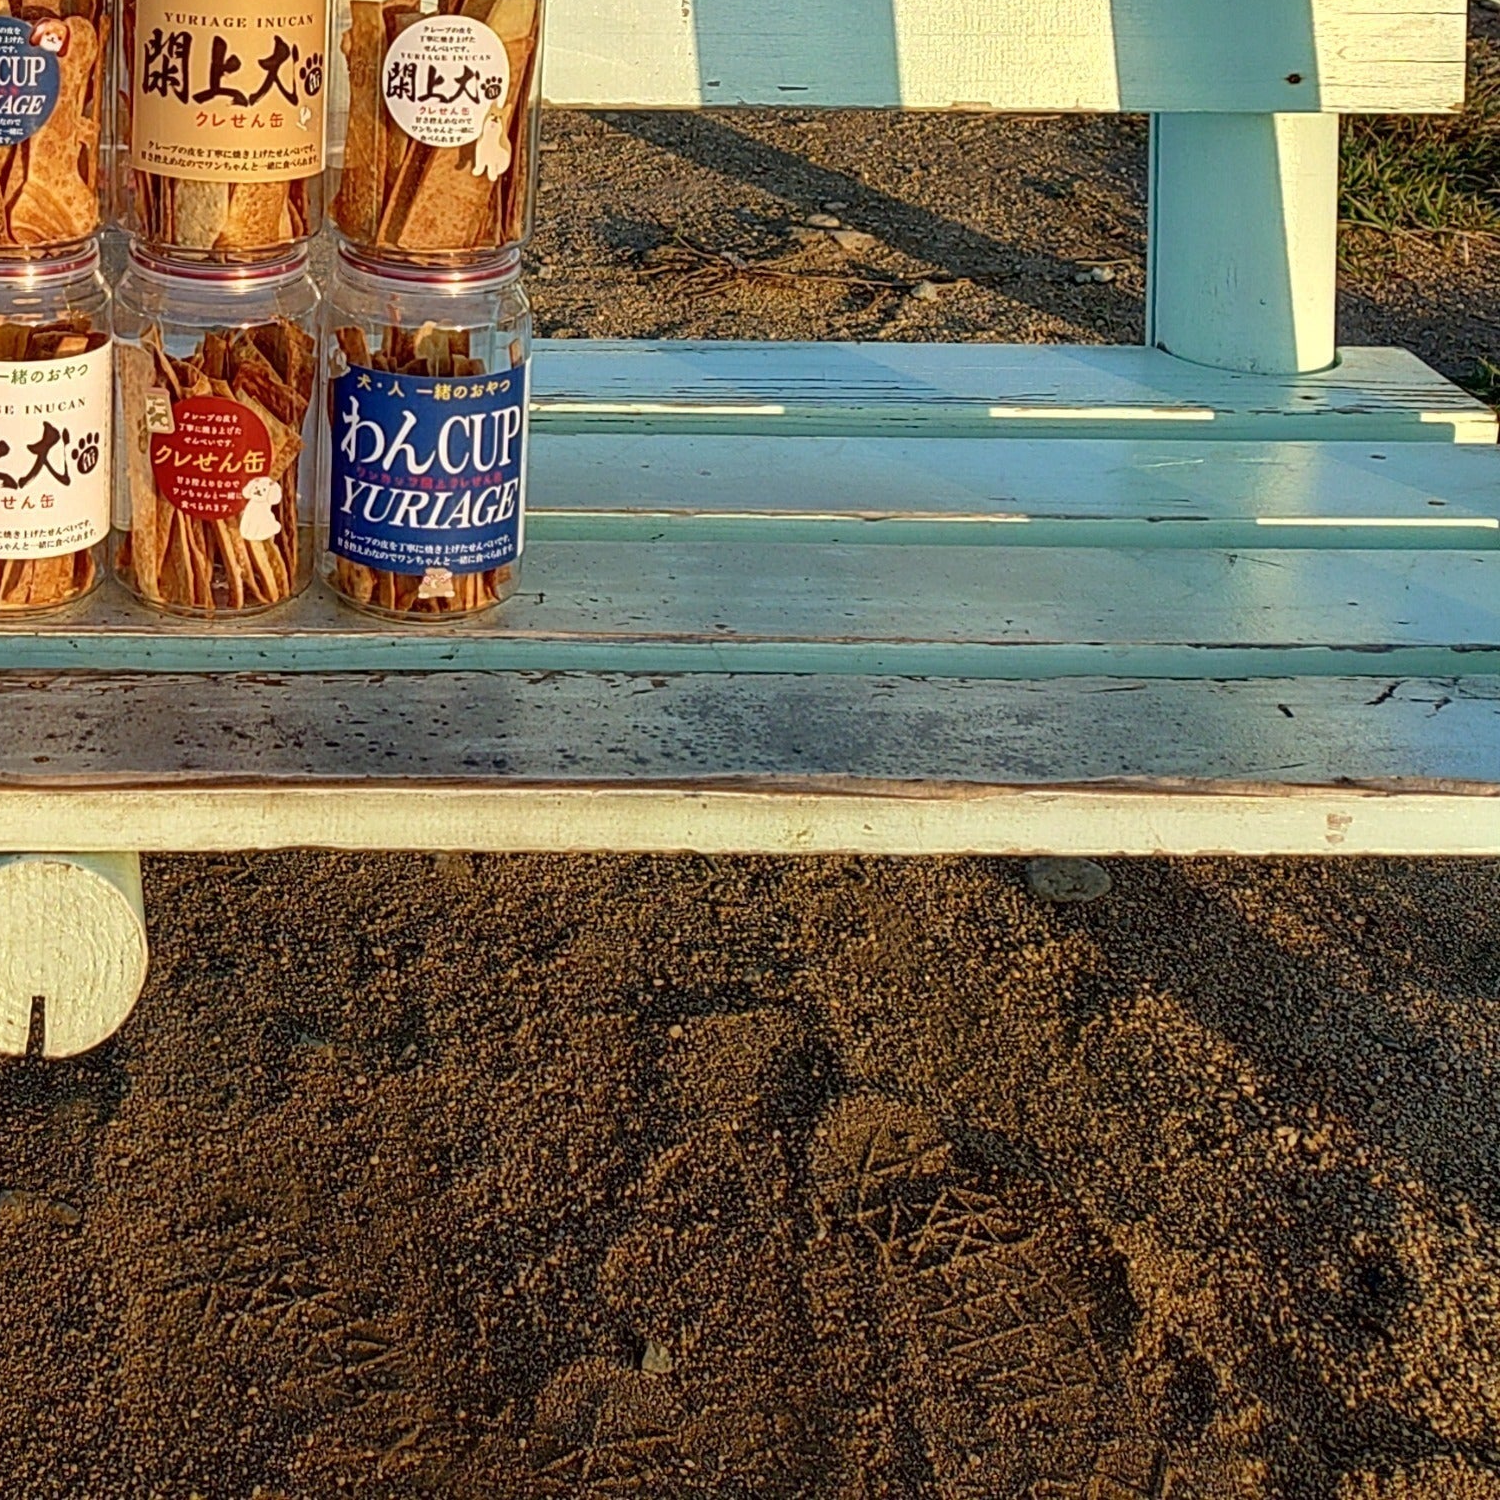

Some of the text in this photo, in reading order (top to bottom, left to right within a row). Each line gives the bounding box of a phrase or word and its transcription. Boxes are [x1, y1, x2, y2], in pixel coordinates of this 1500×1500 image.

[164, 12, 314, 28] YURIAGE INUCAN
[401, 53, 447, 61] YURIAGE
[419, 106, 469, 115] クレせん缶
[196, 111, 284, 128] クレせん缶
[25, 397, 86, 415] INUCAN
[341, 396, 521, 475] わんCUP
[155, 445, 265, 473] クレせん缶
[340, 476, 519, 529] YURIAGE
